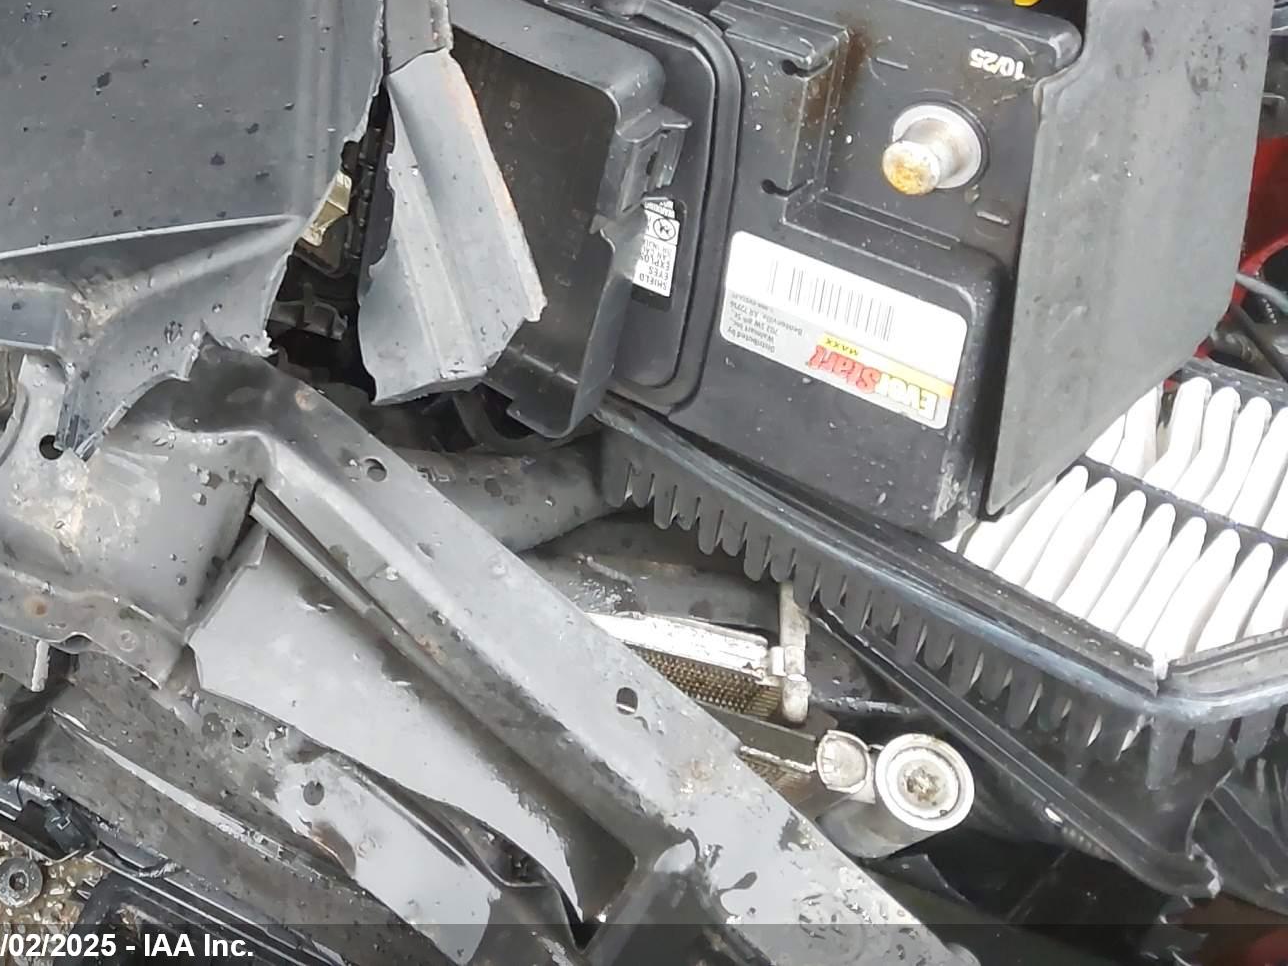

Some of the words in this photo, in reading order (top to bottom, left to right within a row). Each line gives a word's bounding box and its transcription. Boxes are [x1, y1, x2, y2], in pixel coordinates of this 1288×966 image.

[968, 47, 1026, 81] 10/25
[639, 273, 667, 291] SHIELD
[648, 266, 669, 280] EYES
[727, 327, 736, 336] by
[744, 327, 774, 342] Walmart
[737, 332, 775, 353] Distributed
[825, 338, 859, 357] MAXX
[807, 345, 939, 421] EverStart
